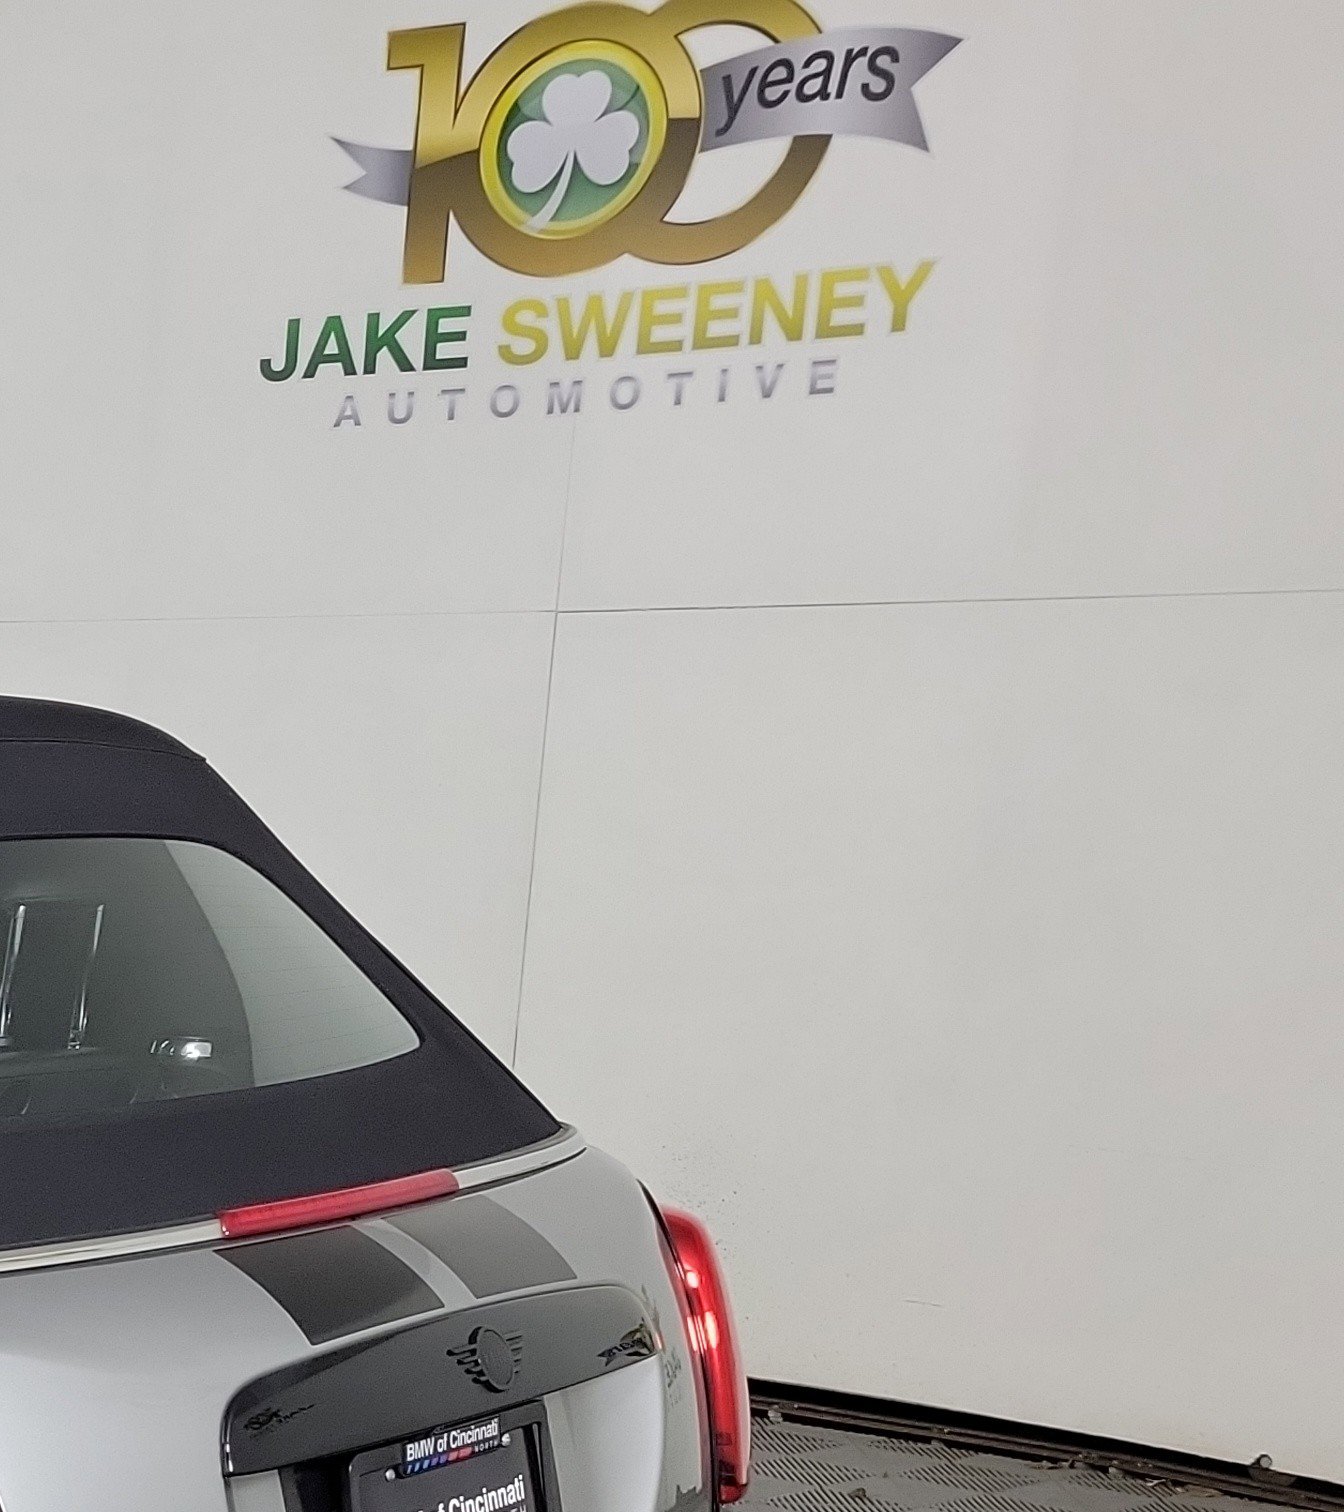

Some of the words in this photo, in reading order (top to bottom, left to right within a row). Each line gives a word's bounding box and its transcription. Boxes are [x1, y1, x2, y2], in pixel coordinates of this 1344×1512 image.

[715, 44, 901, 136] years
[259, 304, 472, 383] JAKE
[497, 258, 938, 367] SWEENEY
[333, 358, 838, 429] AUTOMOTIVE
[405, 1436, 436, 1462] BMW
[436, 1432, 448, 1453] of
[449, 1417, 499, 1449] Cincinnati
[474, 1440, 499, 1453] NORTH
